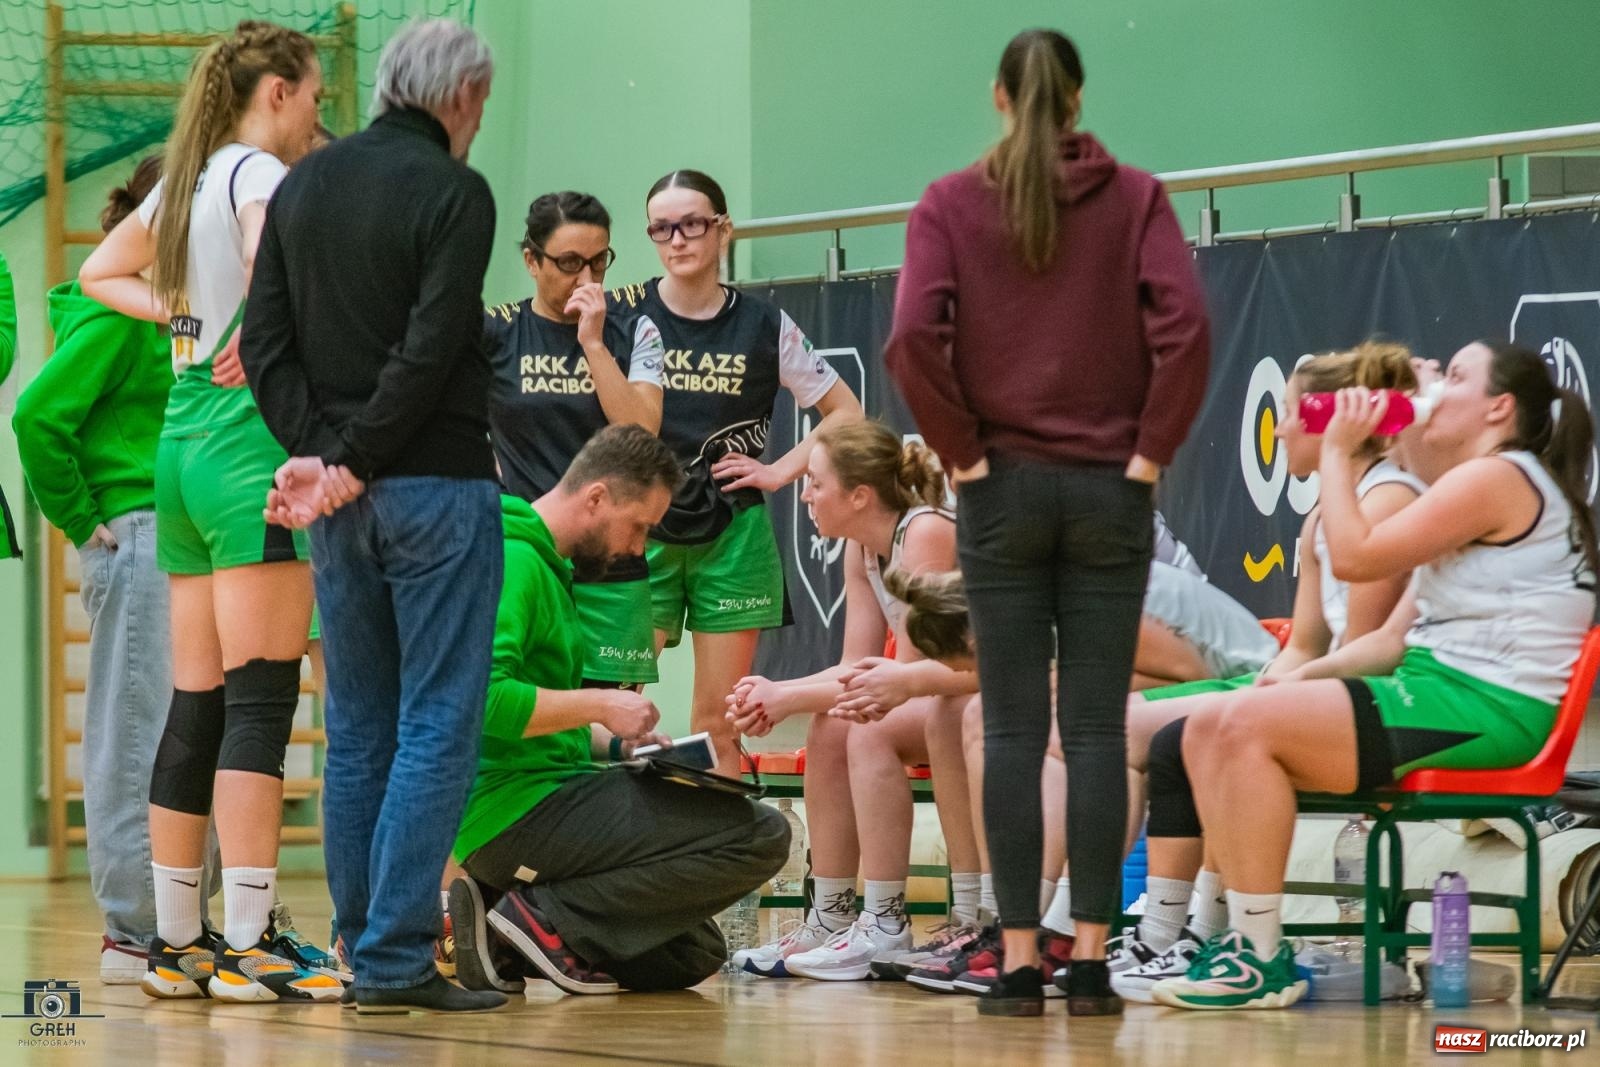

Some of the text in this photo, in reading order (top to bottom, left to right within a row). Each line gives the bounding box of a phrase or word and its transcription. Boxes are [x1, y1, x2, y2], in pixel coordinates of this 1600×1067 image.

[520, 354, 569, 376] RKK
[662, 349, 747, 375] KK AZS
[521, 375, 596, 394] RACIBÓ
[660, 371, 744, 395] ACIBÓRZ
